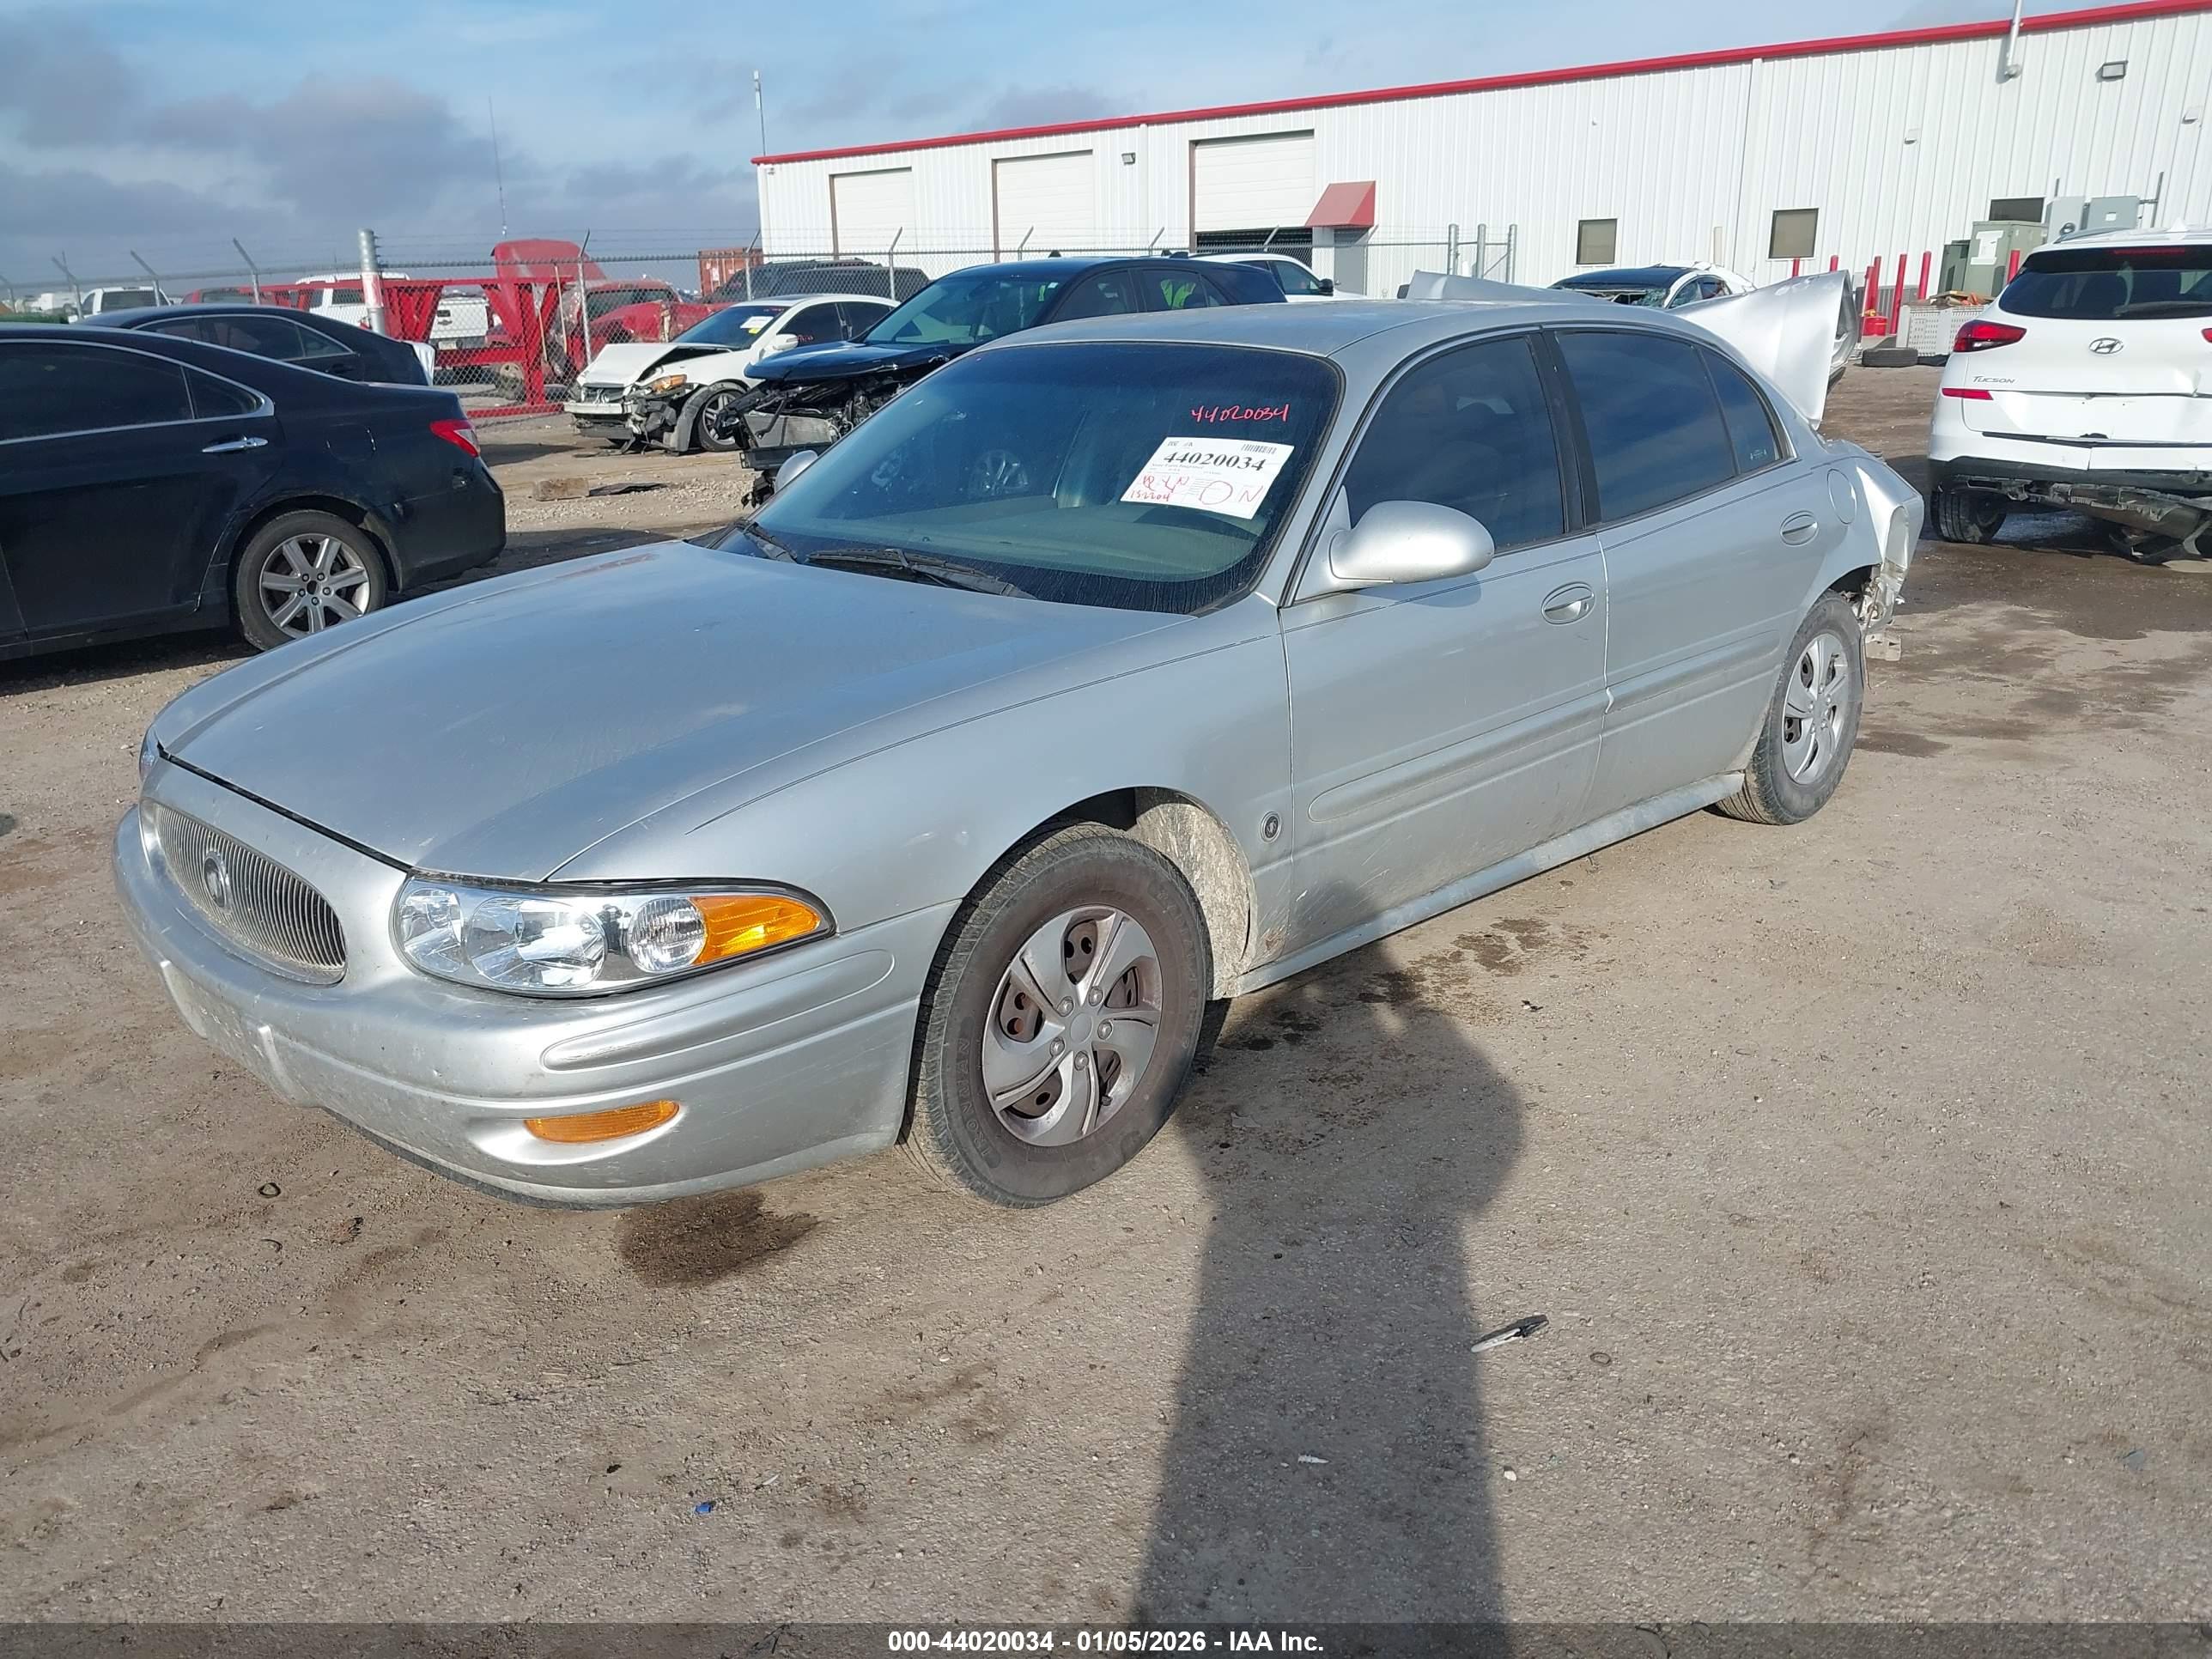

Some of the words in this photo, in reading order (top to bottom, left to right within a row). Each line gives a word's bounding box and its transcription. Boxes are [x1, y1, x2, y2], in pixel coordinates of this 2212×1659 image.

[1192, 404, 1289, 422] 44020034
[1164, 452, 1267, 471] 44020034
[957, 1037, 991, 1157] IRONMAN
